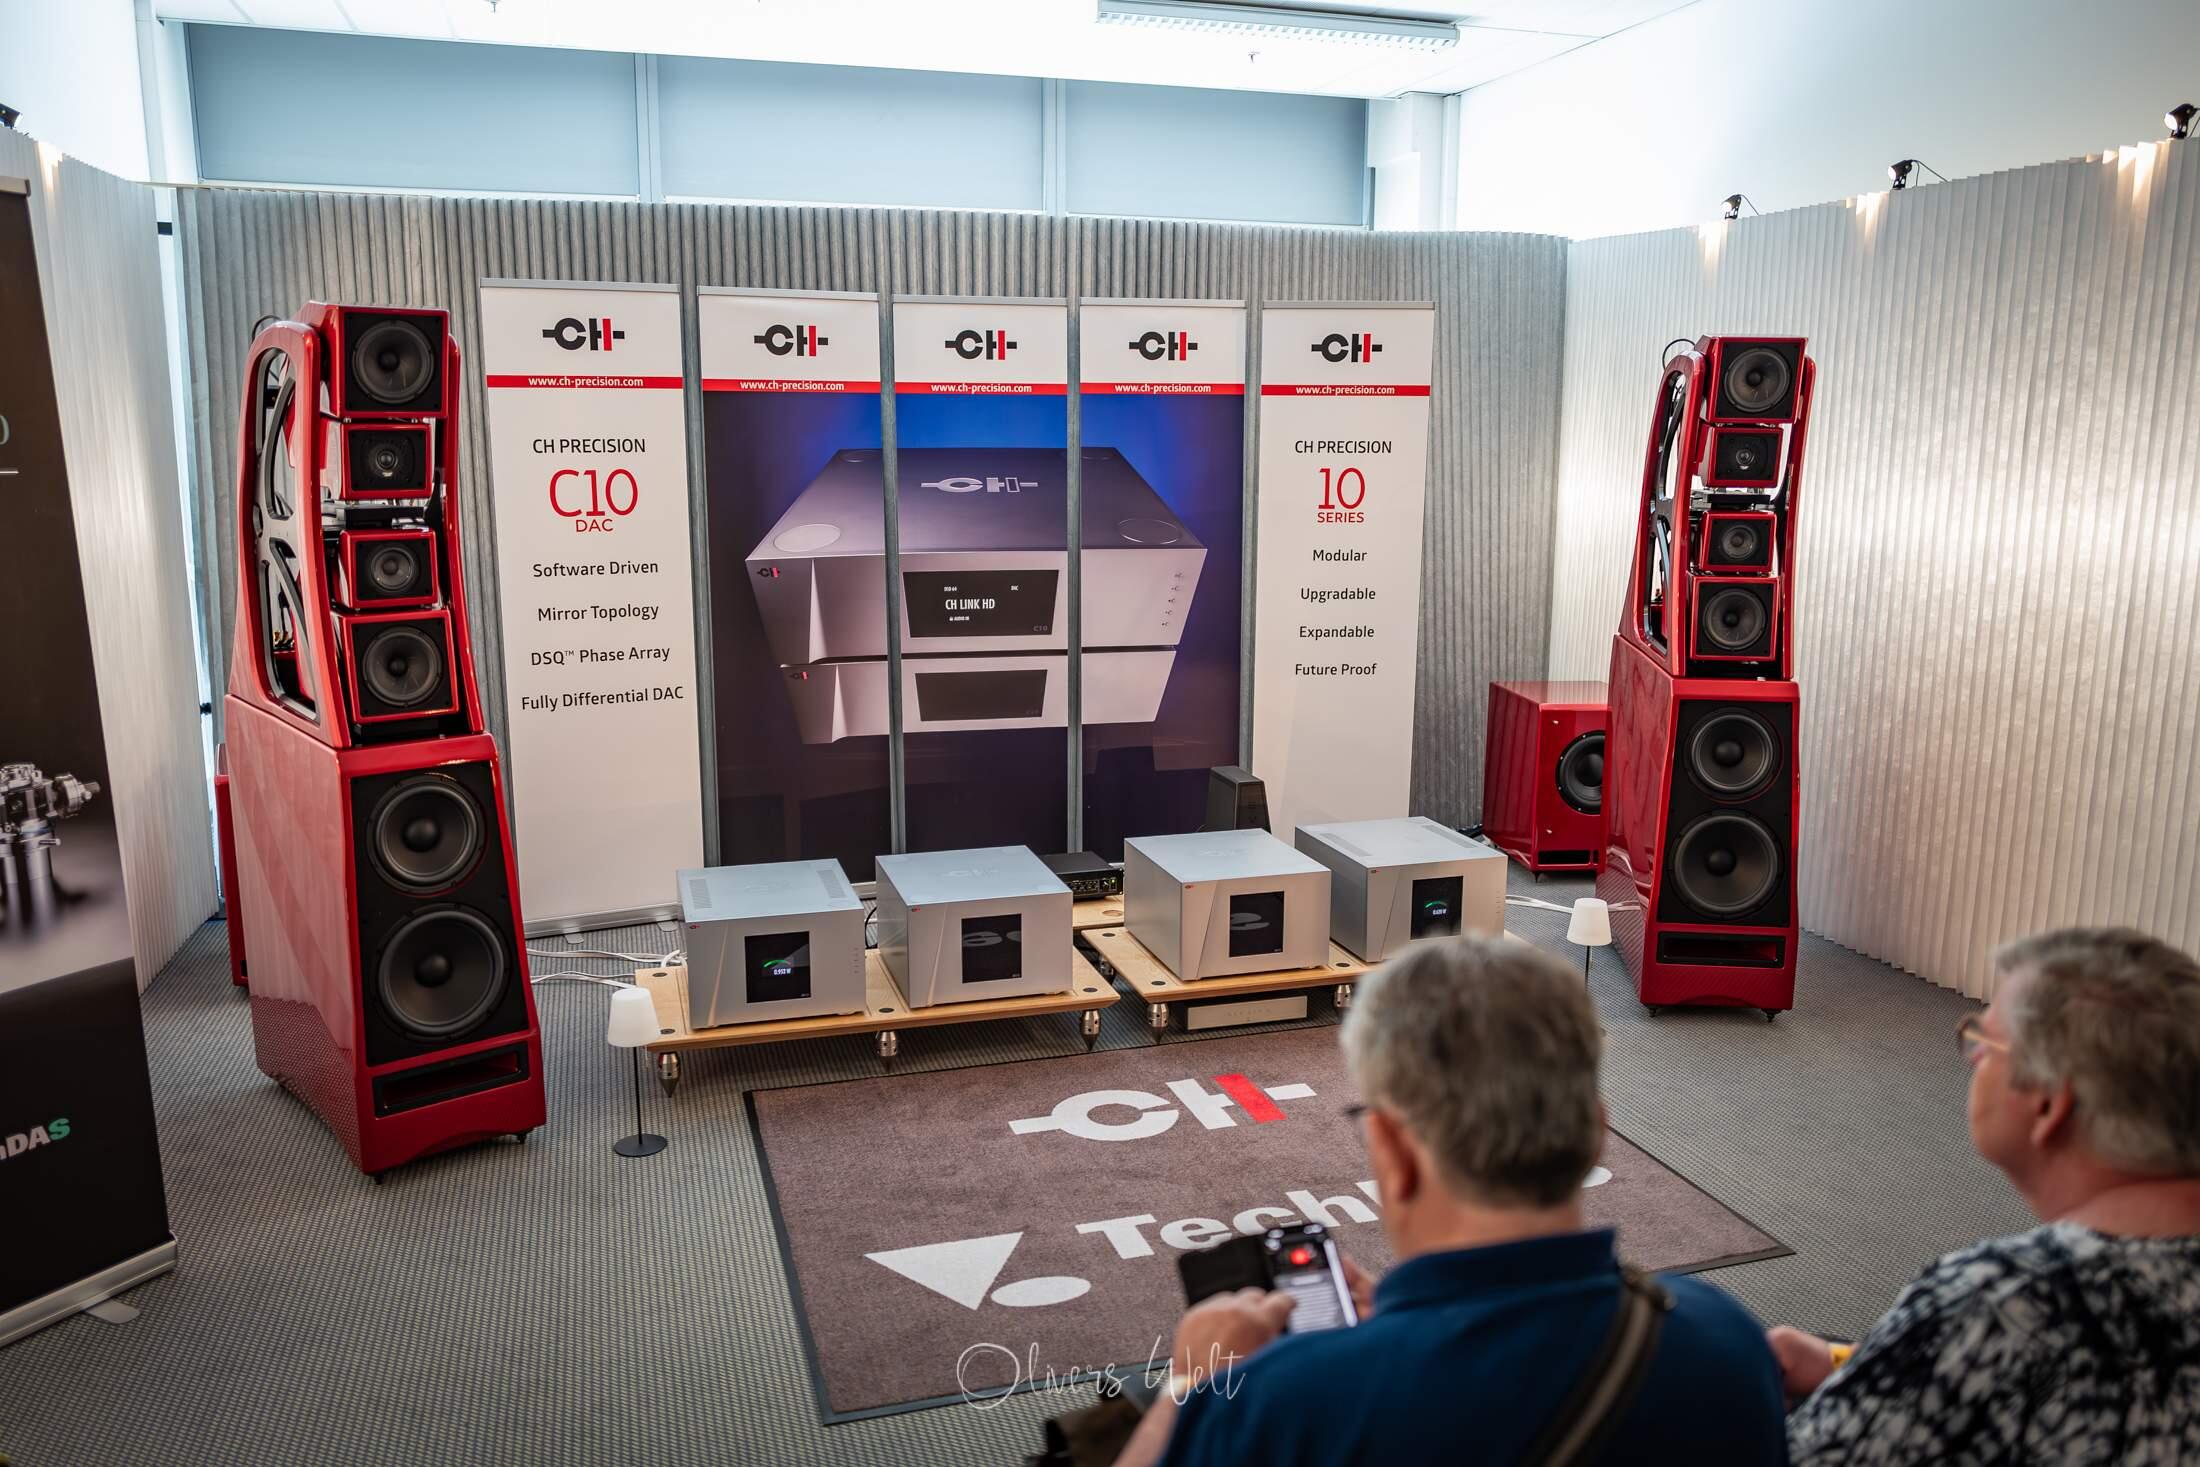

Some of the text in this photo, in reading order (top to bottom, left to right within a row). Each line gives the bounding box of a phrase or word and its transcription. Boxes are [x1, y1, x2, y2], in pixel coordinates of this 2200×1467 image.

[528, 376, 644, 388] www.ch-precision.com
[739, 380, 845, 392] www.ch-precision.com
[930, 382, 1033, 394] www.ch-precision.com
[1114, 383, 1212, 395] www.ch-precision.com
[1295, 385, 1396, 397] www.ch-precision.com
[532, 438, 646, 454] CH PRECISION
[1294, 440, 1392, 454] CH PRECISION
[549, 468, 639, 518] C10
[1317, 467, 1367, 510] 10
[1316, 511, 1365, 524] SERIES
[575, 518, 614, 533] DAC
[1312, 548, 1368, 562] Modular
[532, 560, 659, 578] Software Driven
[1300, 587, 1376, 604] Upgradable
[945, 598, 996, 610] CH LINK HD
[537, 603, 660, 622] Mirror Topology
[1299, 625, 1375, 641] Expandable
[579, 648, 625, 664] Phase
[629, 646, 671, 664] Array
[1295, 662, 1377, 676] Future Proof
[521, 685, 684, 713] Fully Differential DAC
